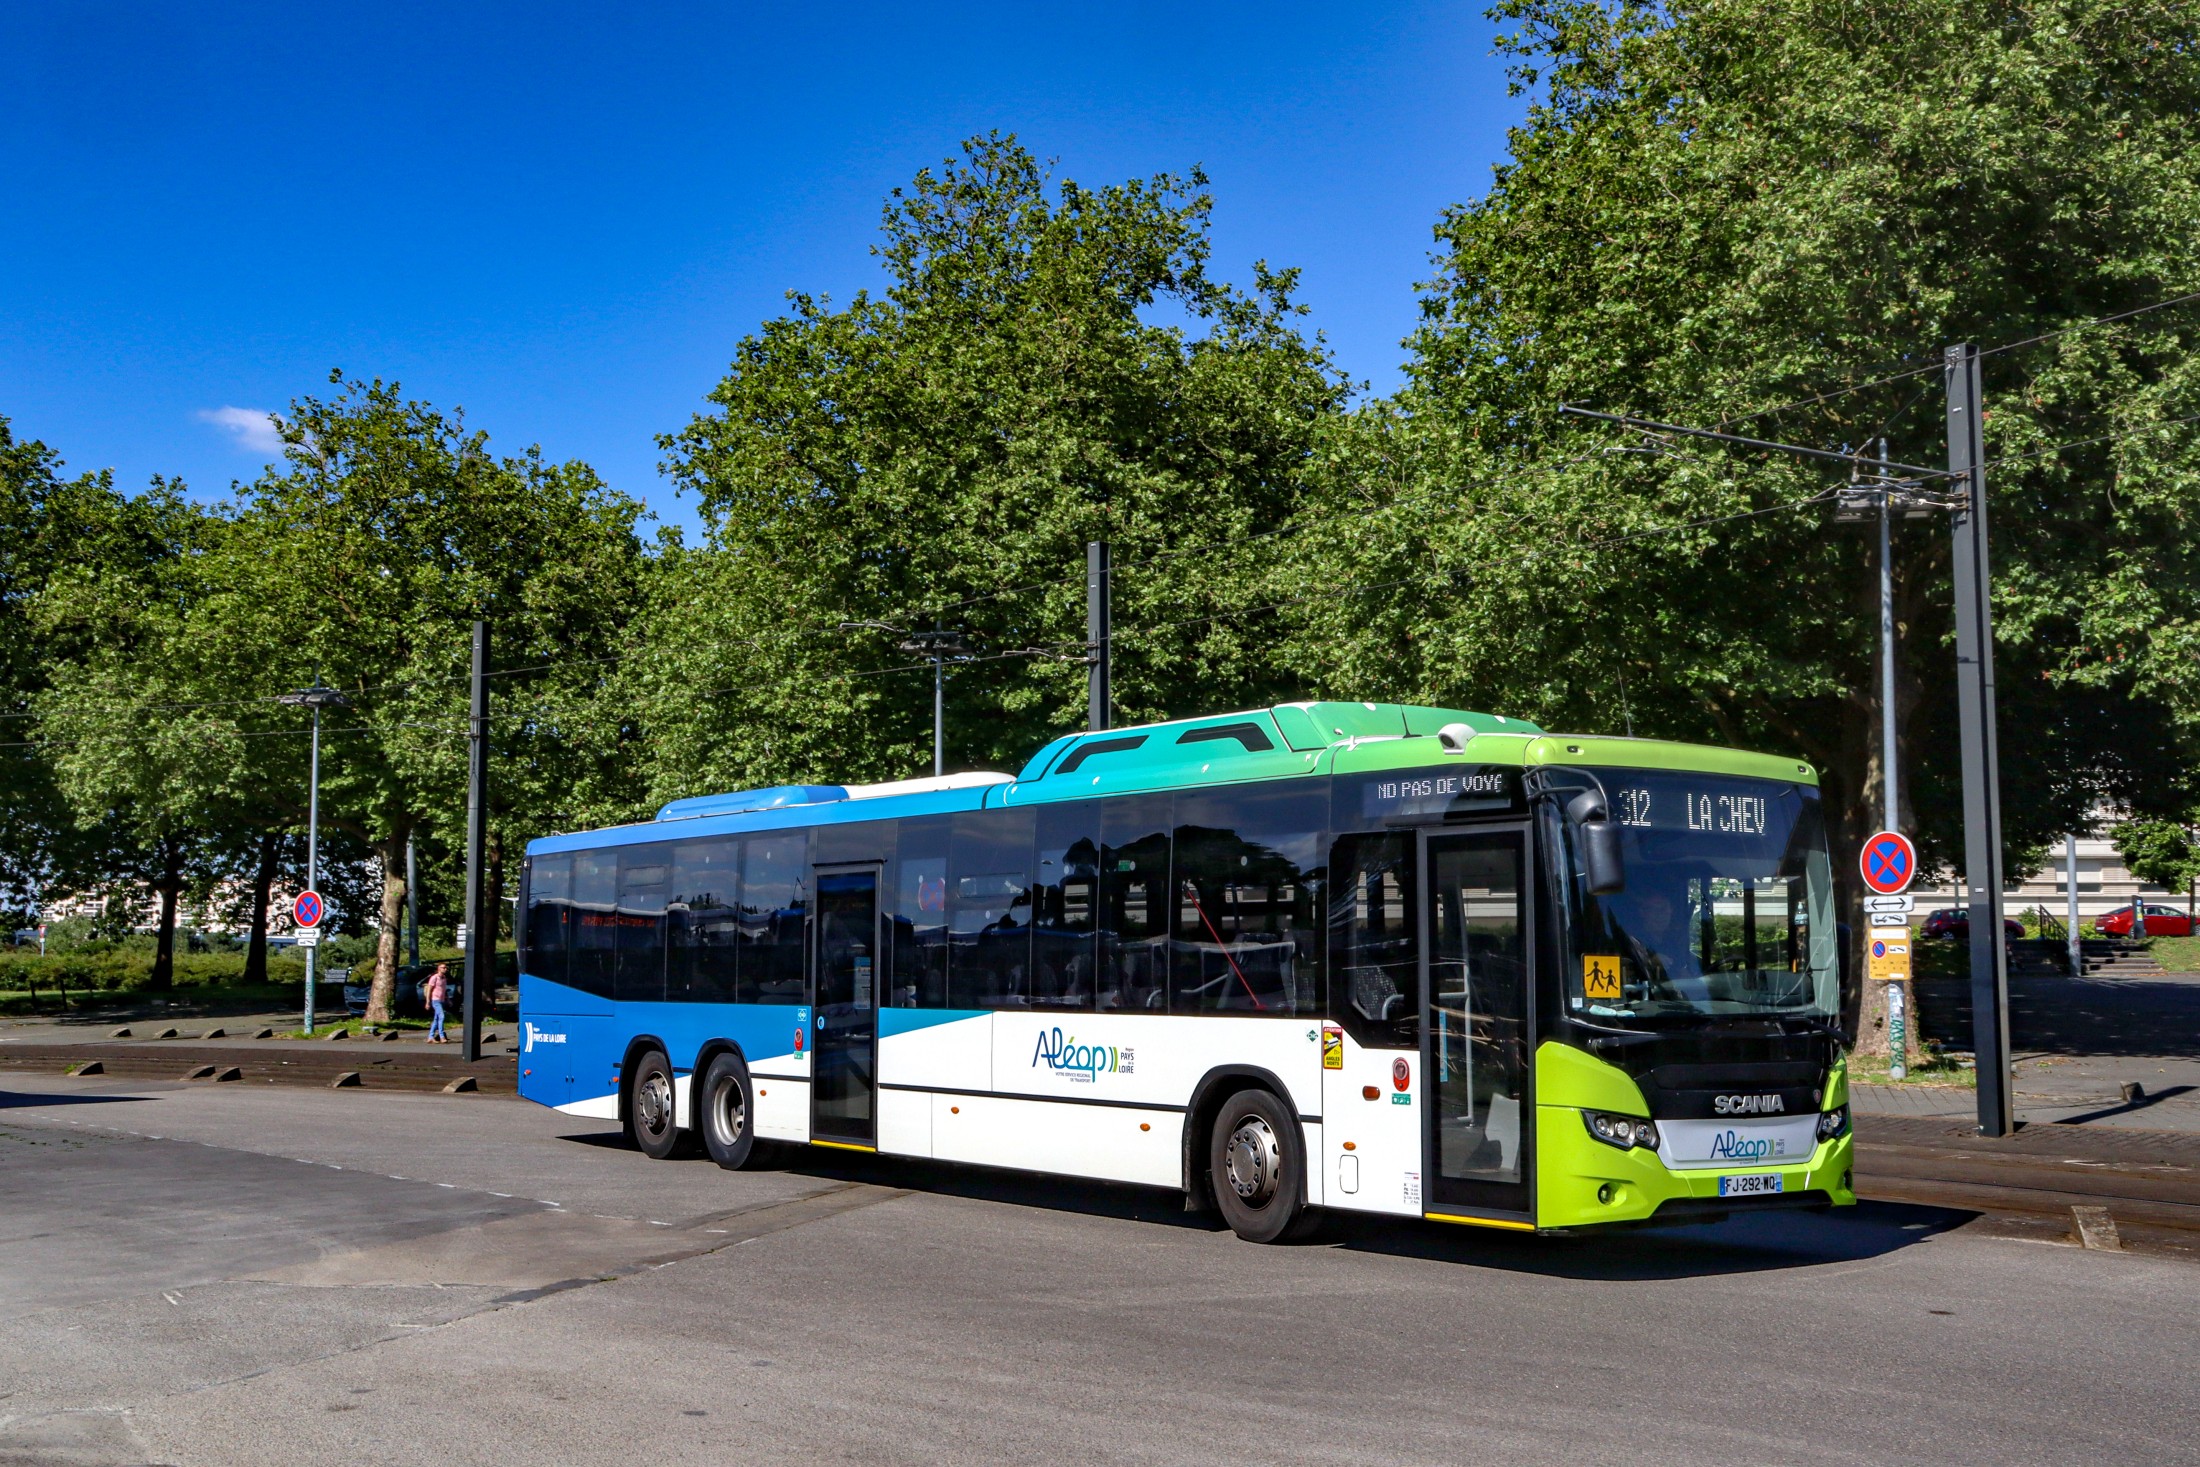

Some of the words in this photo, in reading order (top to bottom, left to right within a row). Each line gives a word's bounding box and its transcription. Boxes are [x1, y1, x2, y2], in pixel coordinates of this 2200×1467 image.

[1378, 783, 1397, 799] ND
[1401, 780, 1432, 797] PAS
[1436, 778, 1457, 794] DE
[1618, 789, 1651, 827] 312
[1687, 793, 1713, 831] LA
[1718, 795, 1765, 834] CHEV
[533, 1033, 543, 1042] PAYS
[543, 1033, 549, 1043] DE
[549, 1034, 554, 1043] LA
[555, 1034, 567, 1043] LOIRE
[1120, 1052, 1134, 1061] PAYS
[1118, 1065, 1134, 1074] LOIRE
[1714, 1094, 1785, 1115] SCANIA
